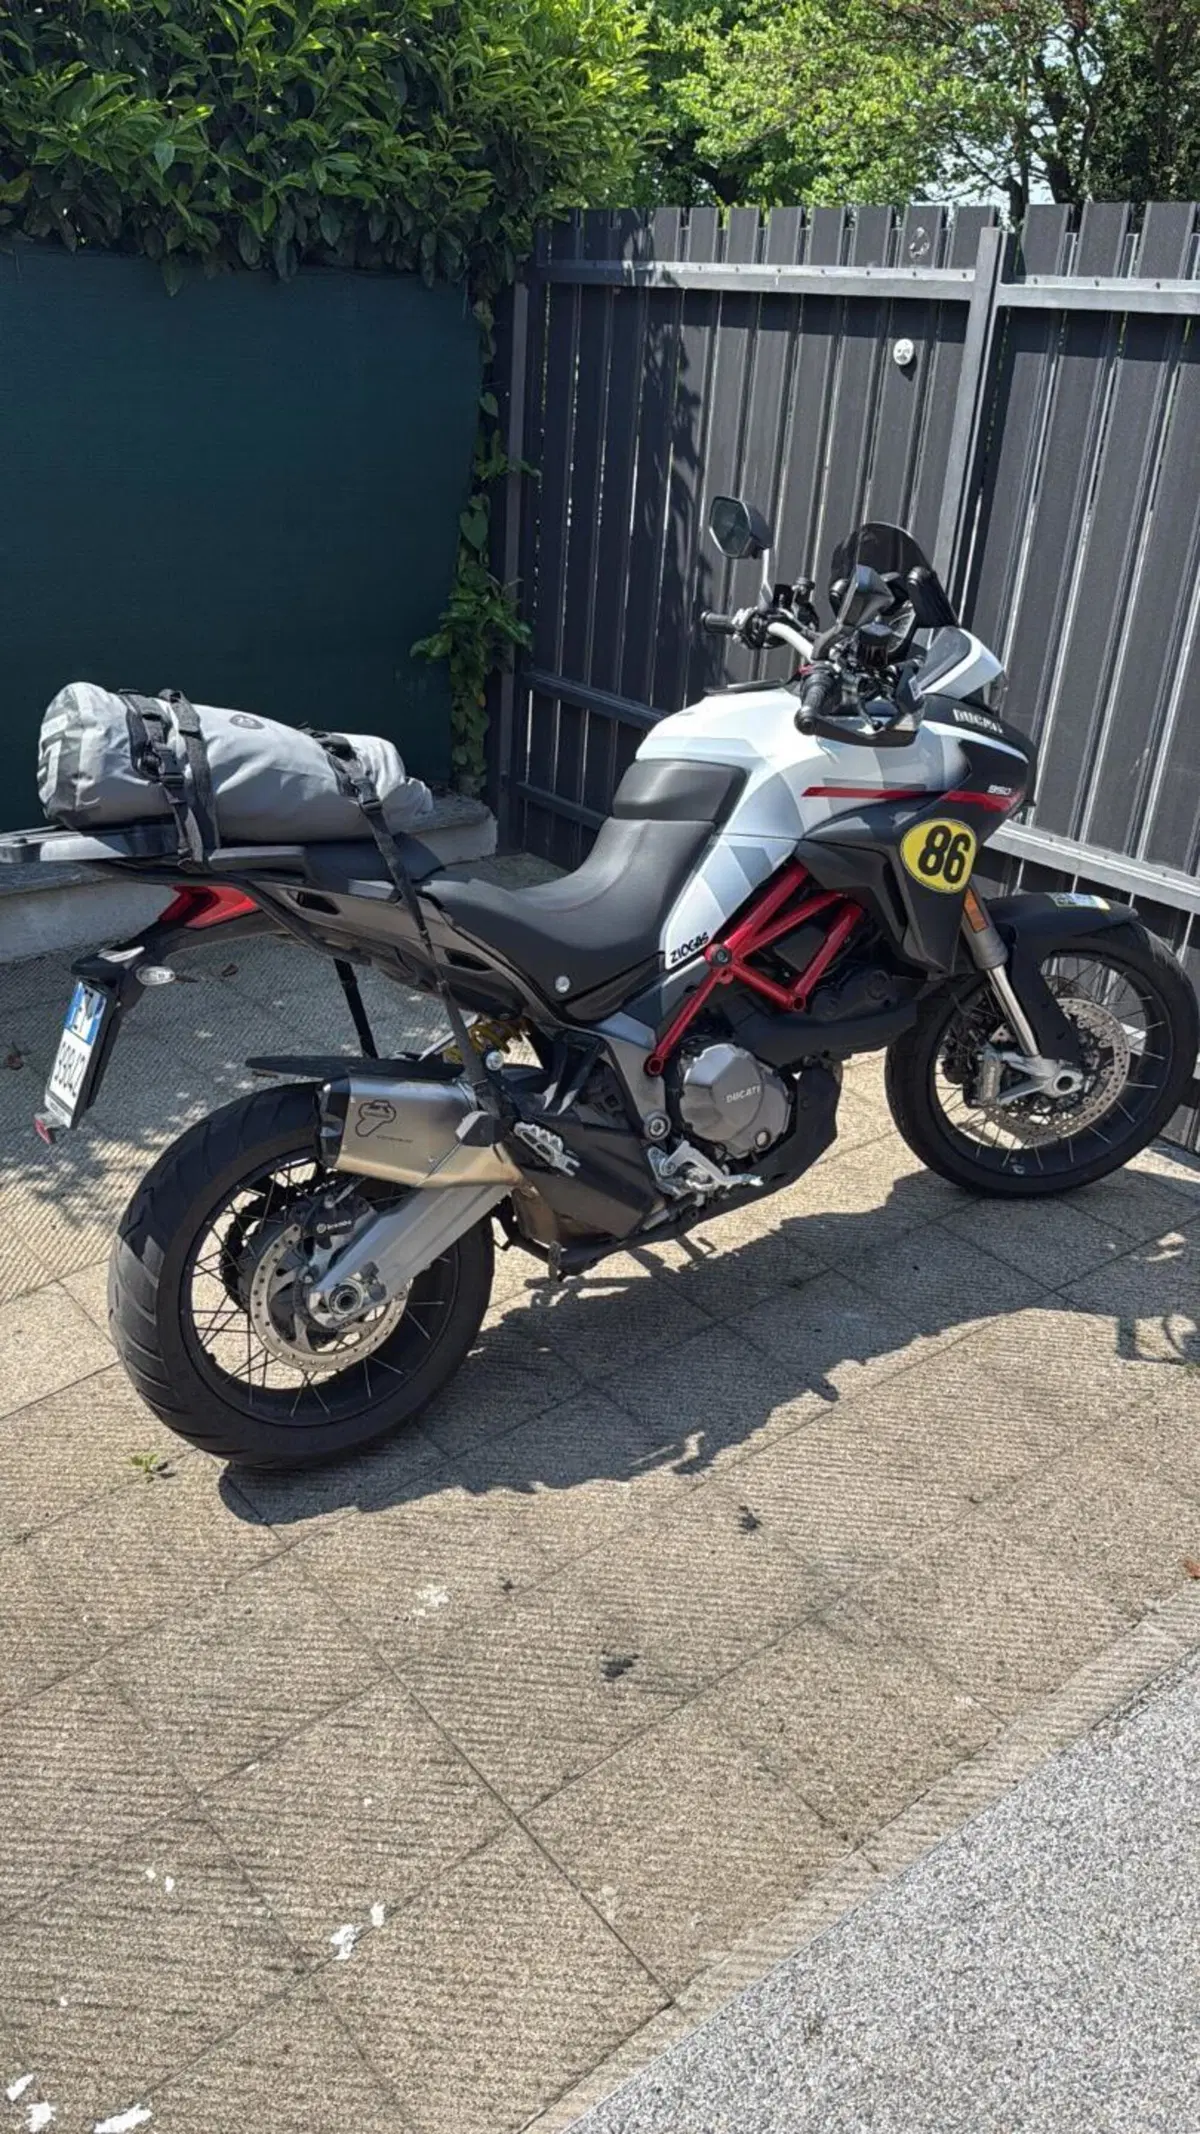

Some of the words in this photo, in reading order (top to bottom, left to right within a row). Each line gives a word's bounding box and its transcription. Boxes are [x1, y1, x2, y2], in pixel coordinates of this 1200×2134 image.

[953, 708, 1003, 733] DUCATI
[918, 825, 971, 884] 86
[726, 1085, 761, 1103] DUCATI
